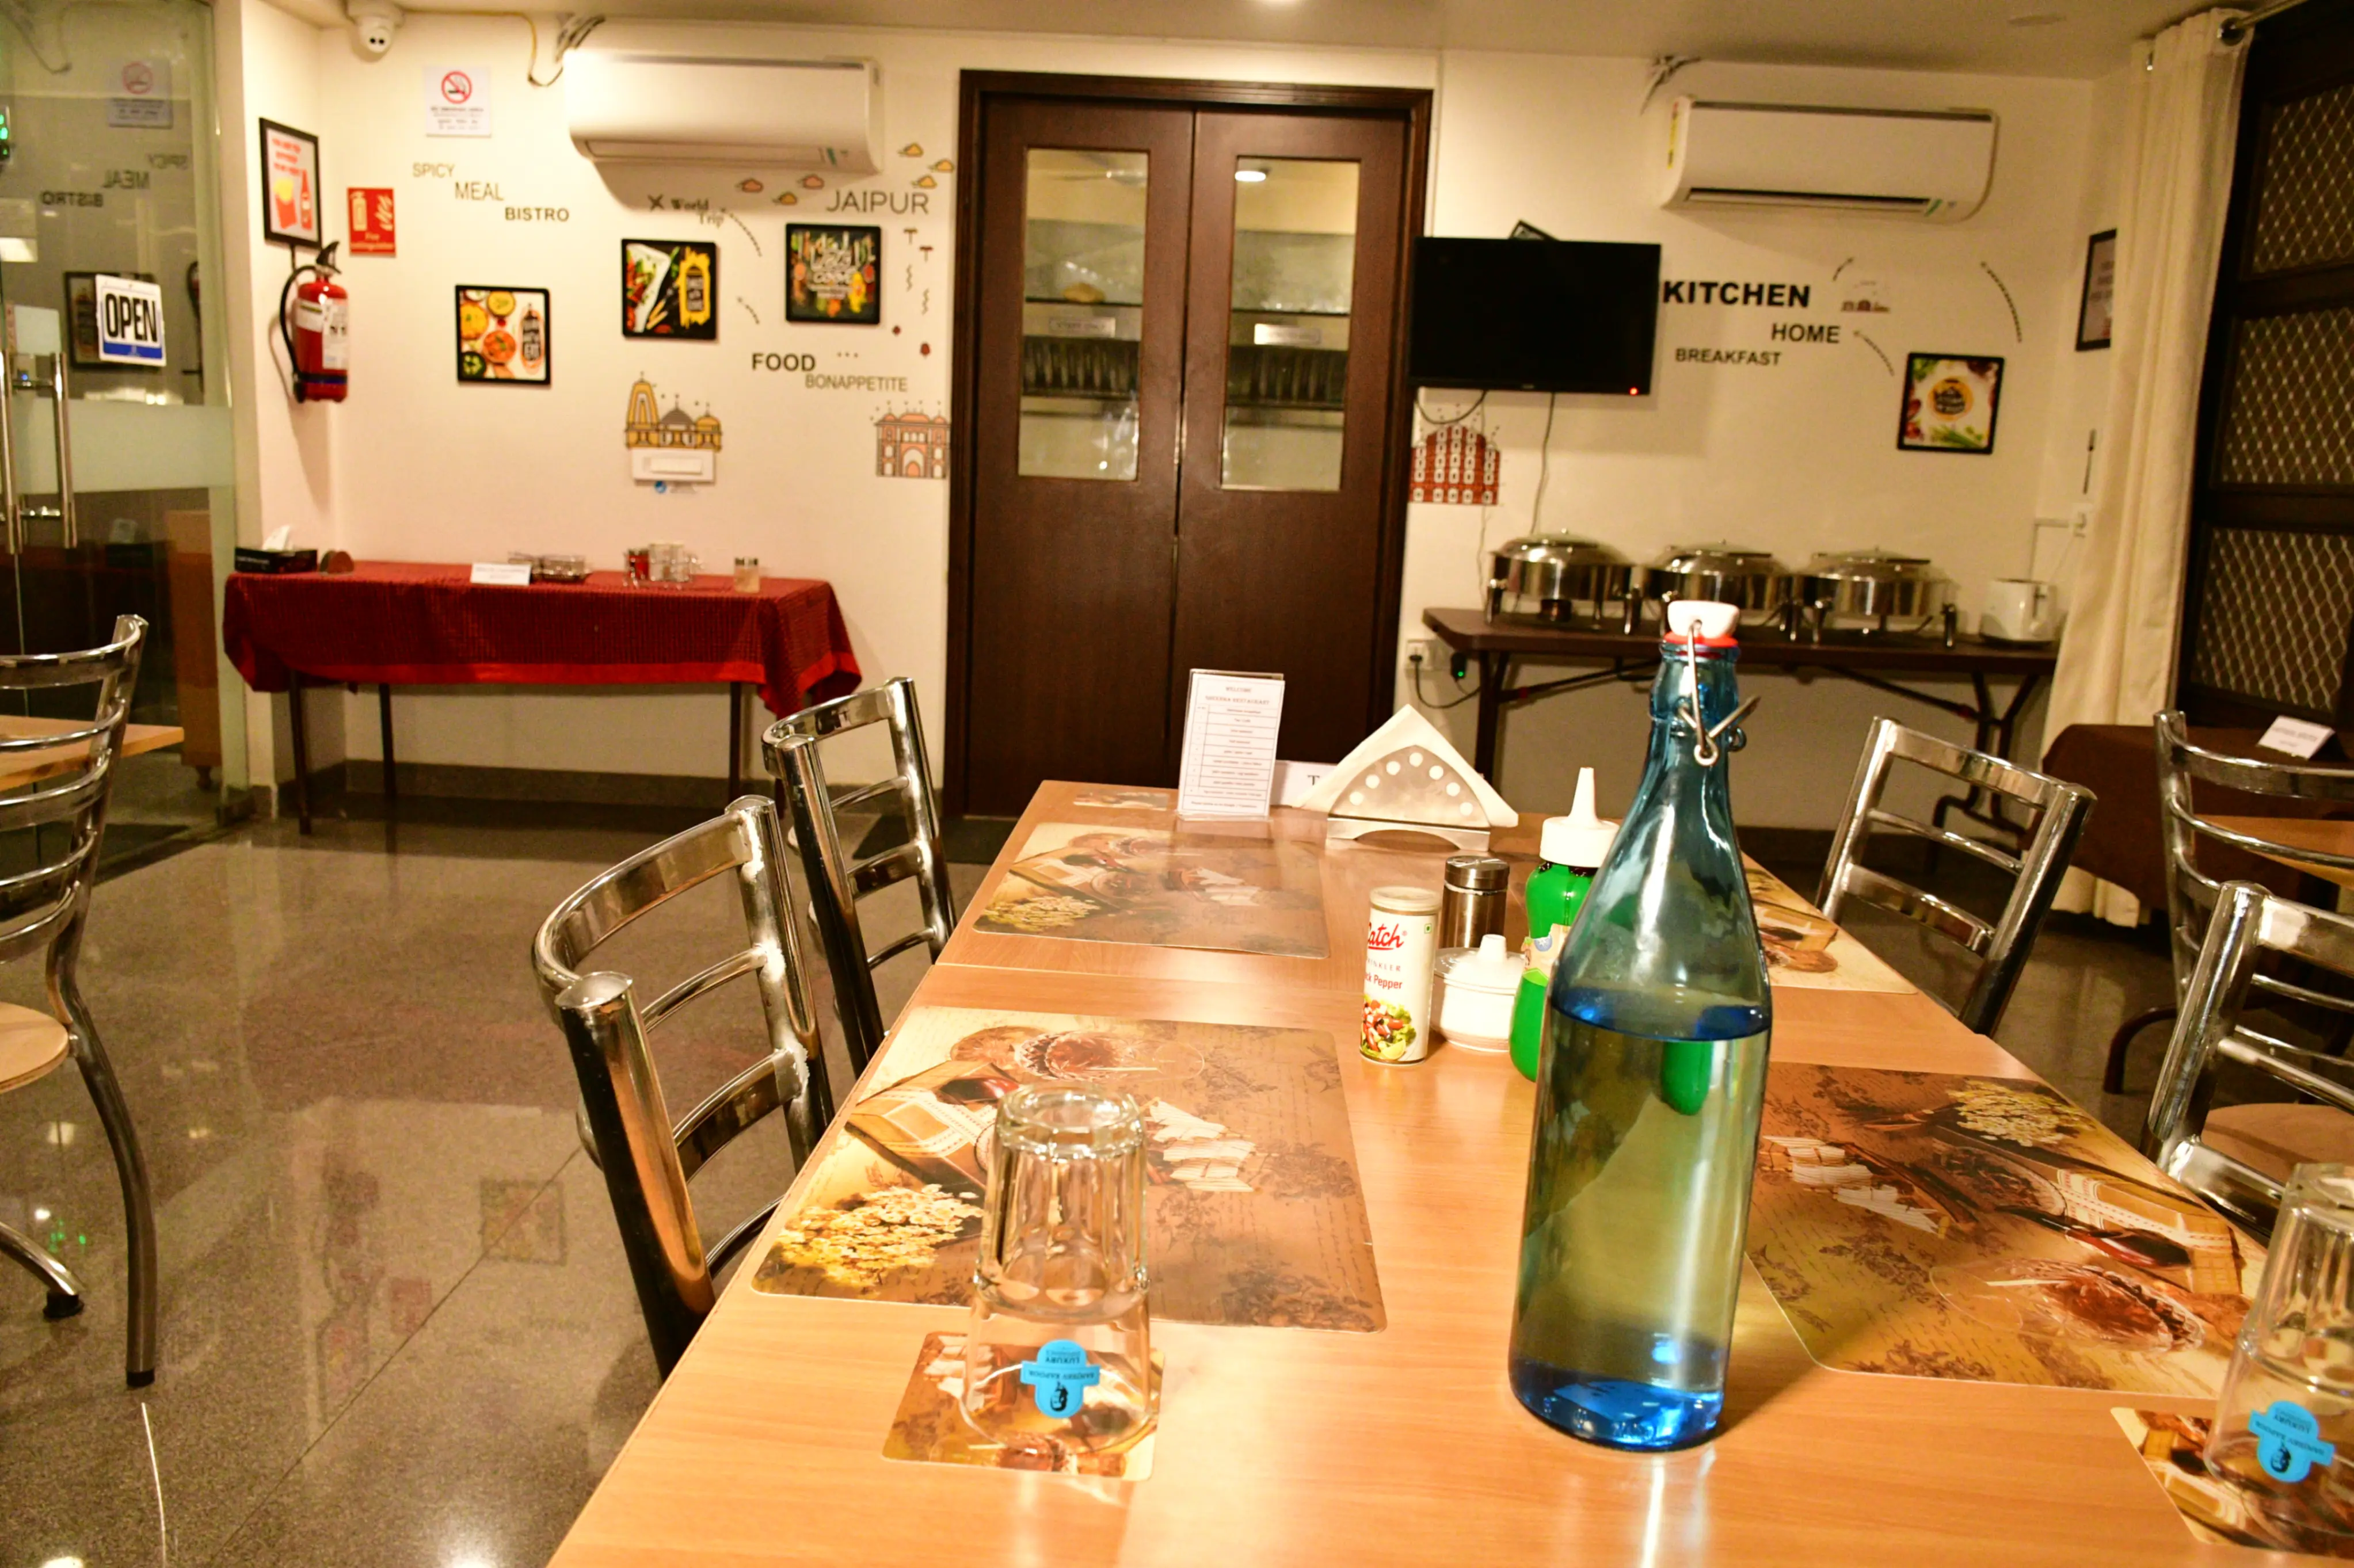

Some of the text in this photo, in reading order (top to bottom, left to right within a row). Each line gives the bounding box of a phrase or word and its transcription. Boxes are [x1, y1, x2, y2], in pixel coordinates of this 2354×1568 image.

[413, 162, 455, 178] SPICY
[455, 182, 504, 201] MEAL
[826, 189, 930, 215] JAIPUR
[505, 207, 569, 222] BISTRO
[1663, 281, 1810, 308] KITCHEN
[105, 293, 158, 343] OPEN
[1772, 323, 1841, 344] HOME
[752, 353, 816, 372] FOOD
[1675, 348, 1782, 366] BREAKFAST
[805, 374, 908, 391] BONAPPETITE
[1367, 921, 1404, 948] atch
[1374, 974, 1403, 990] Pepper
